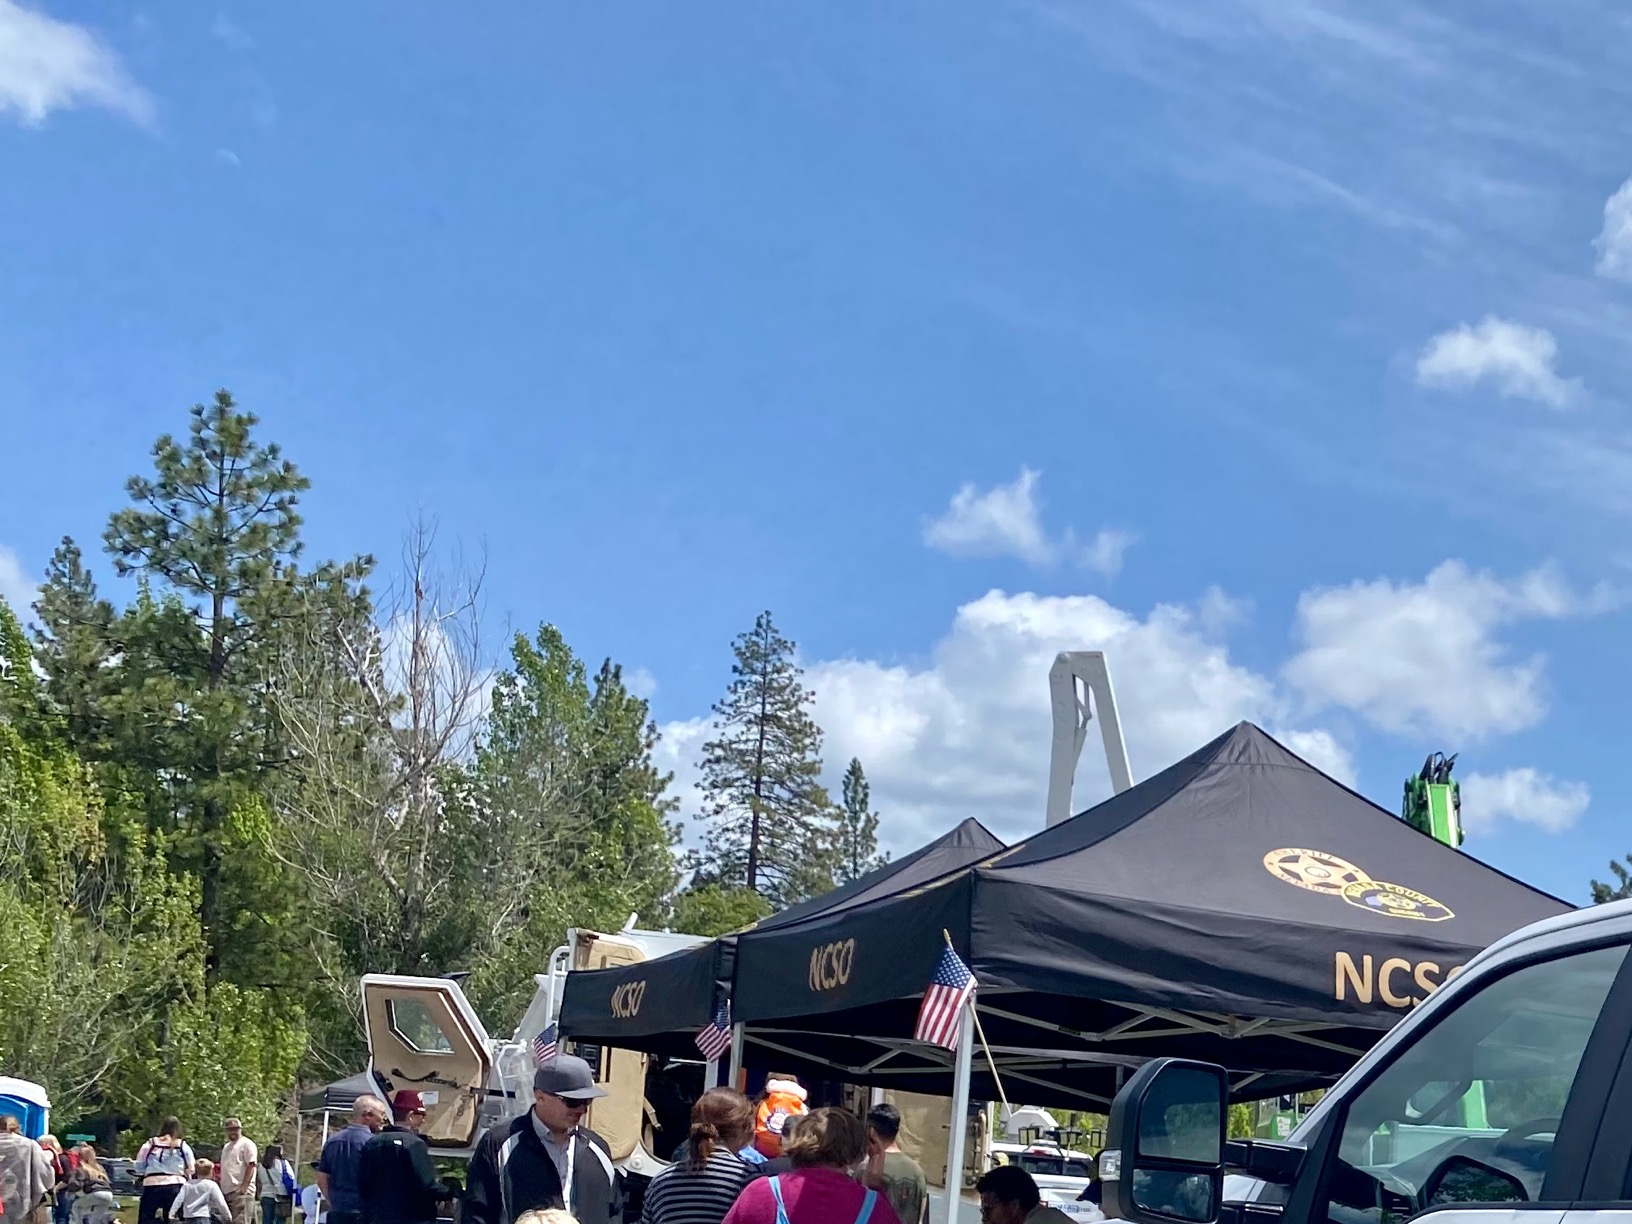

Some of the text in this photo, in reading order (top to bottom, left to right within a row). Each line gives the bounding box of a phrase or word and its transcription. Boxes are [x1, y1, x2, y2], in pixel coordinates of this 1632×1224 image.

[808, 938, 854, 991] NCSO
[1335, 951, 1466, 1008] NCS
[611, 980, 646, 1018] NCSO
